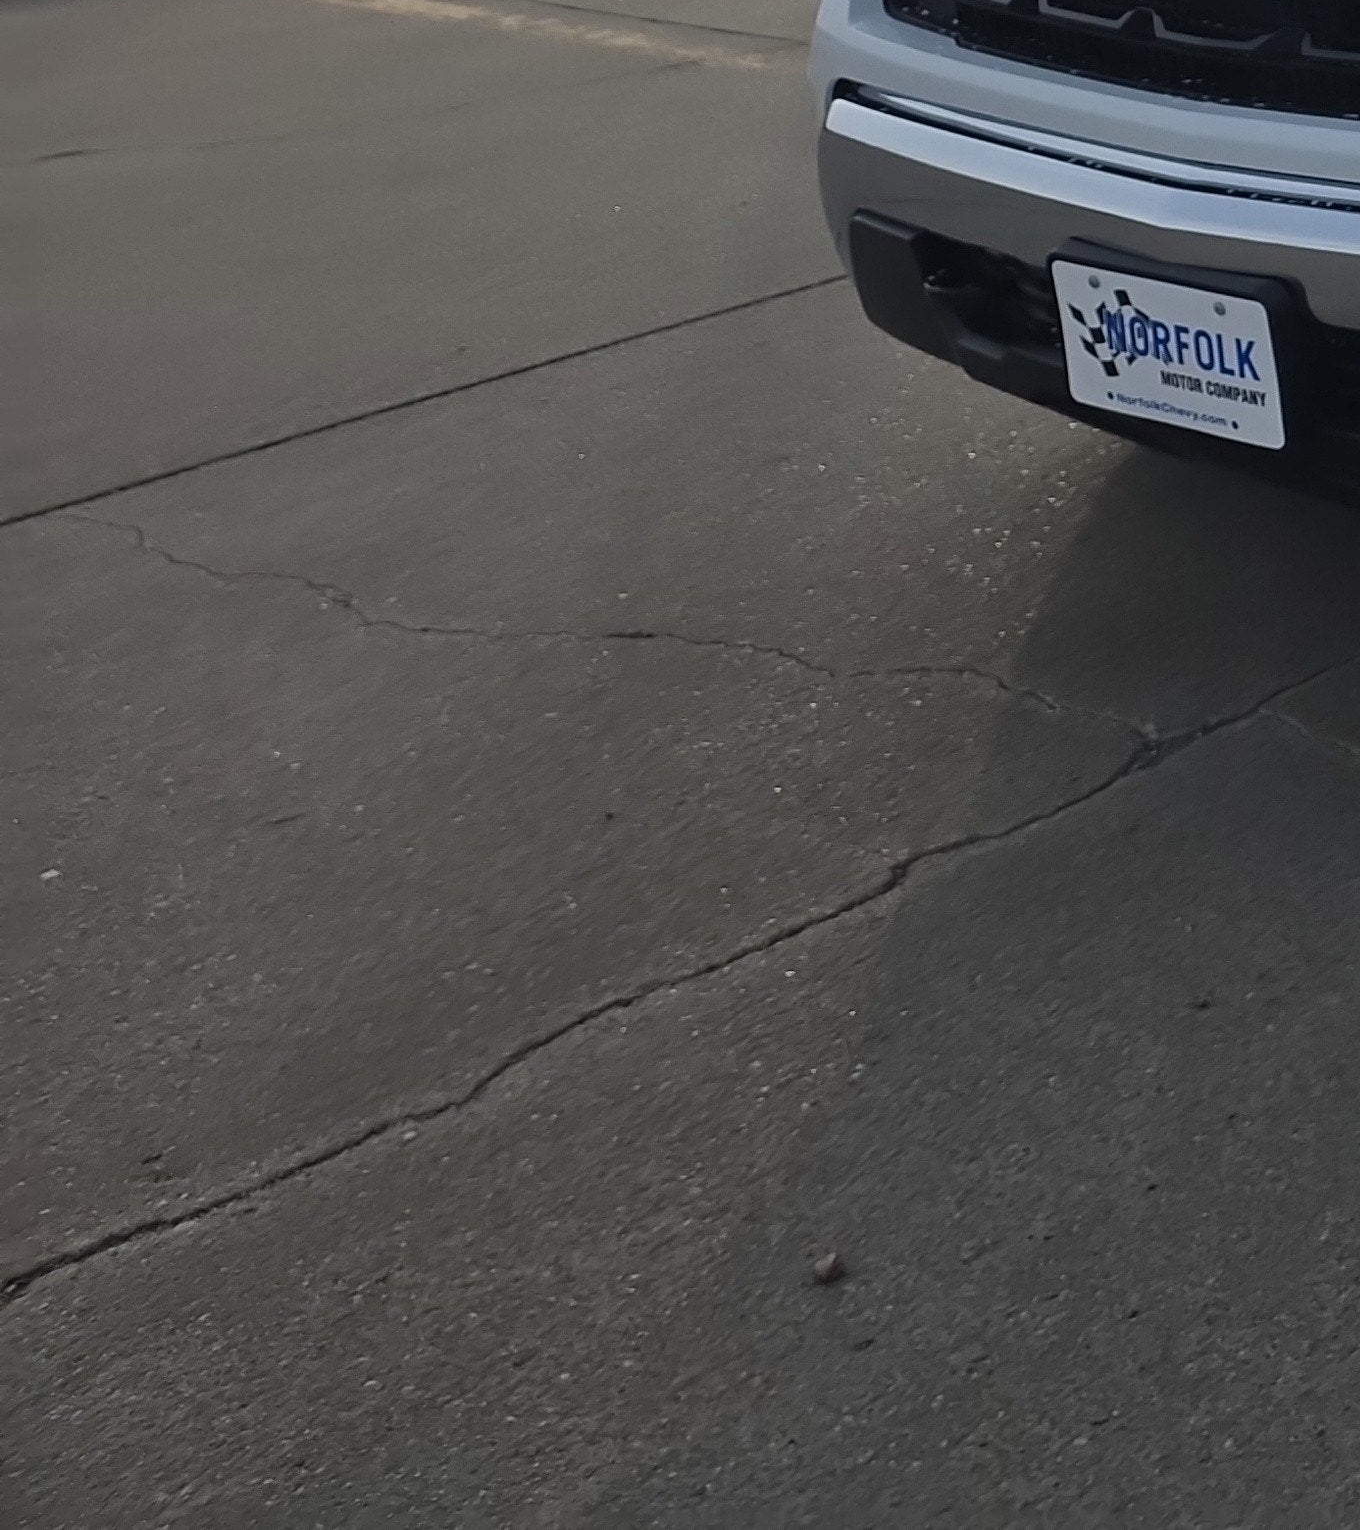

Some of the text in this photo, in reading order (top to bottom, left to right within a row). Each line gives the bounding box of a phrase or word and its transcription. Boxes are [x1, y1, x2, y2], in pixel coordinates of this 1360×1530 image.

[1104, 308, 1261, 381] NORFOLK
[1160, 370, 1267, 407] MOTOR COMPANY
